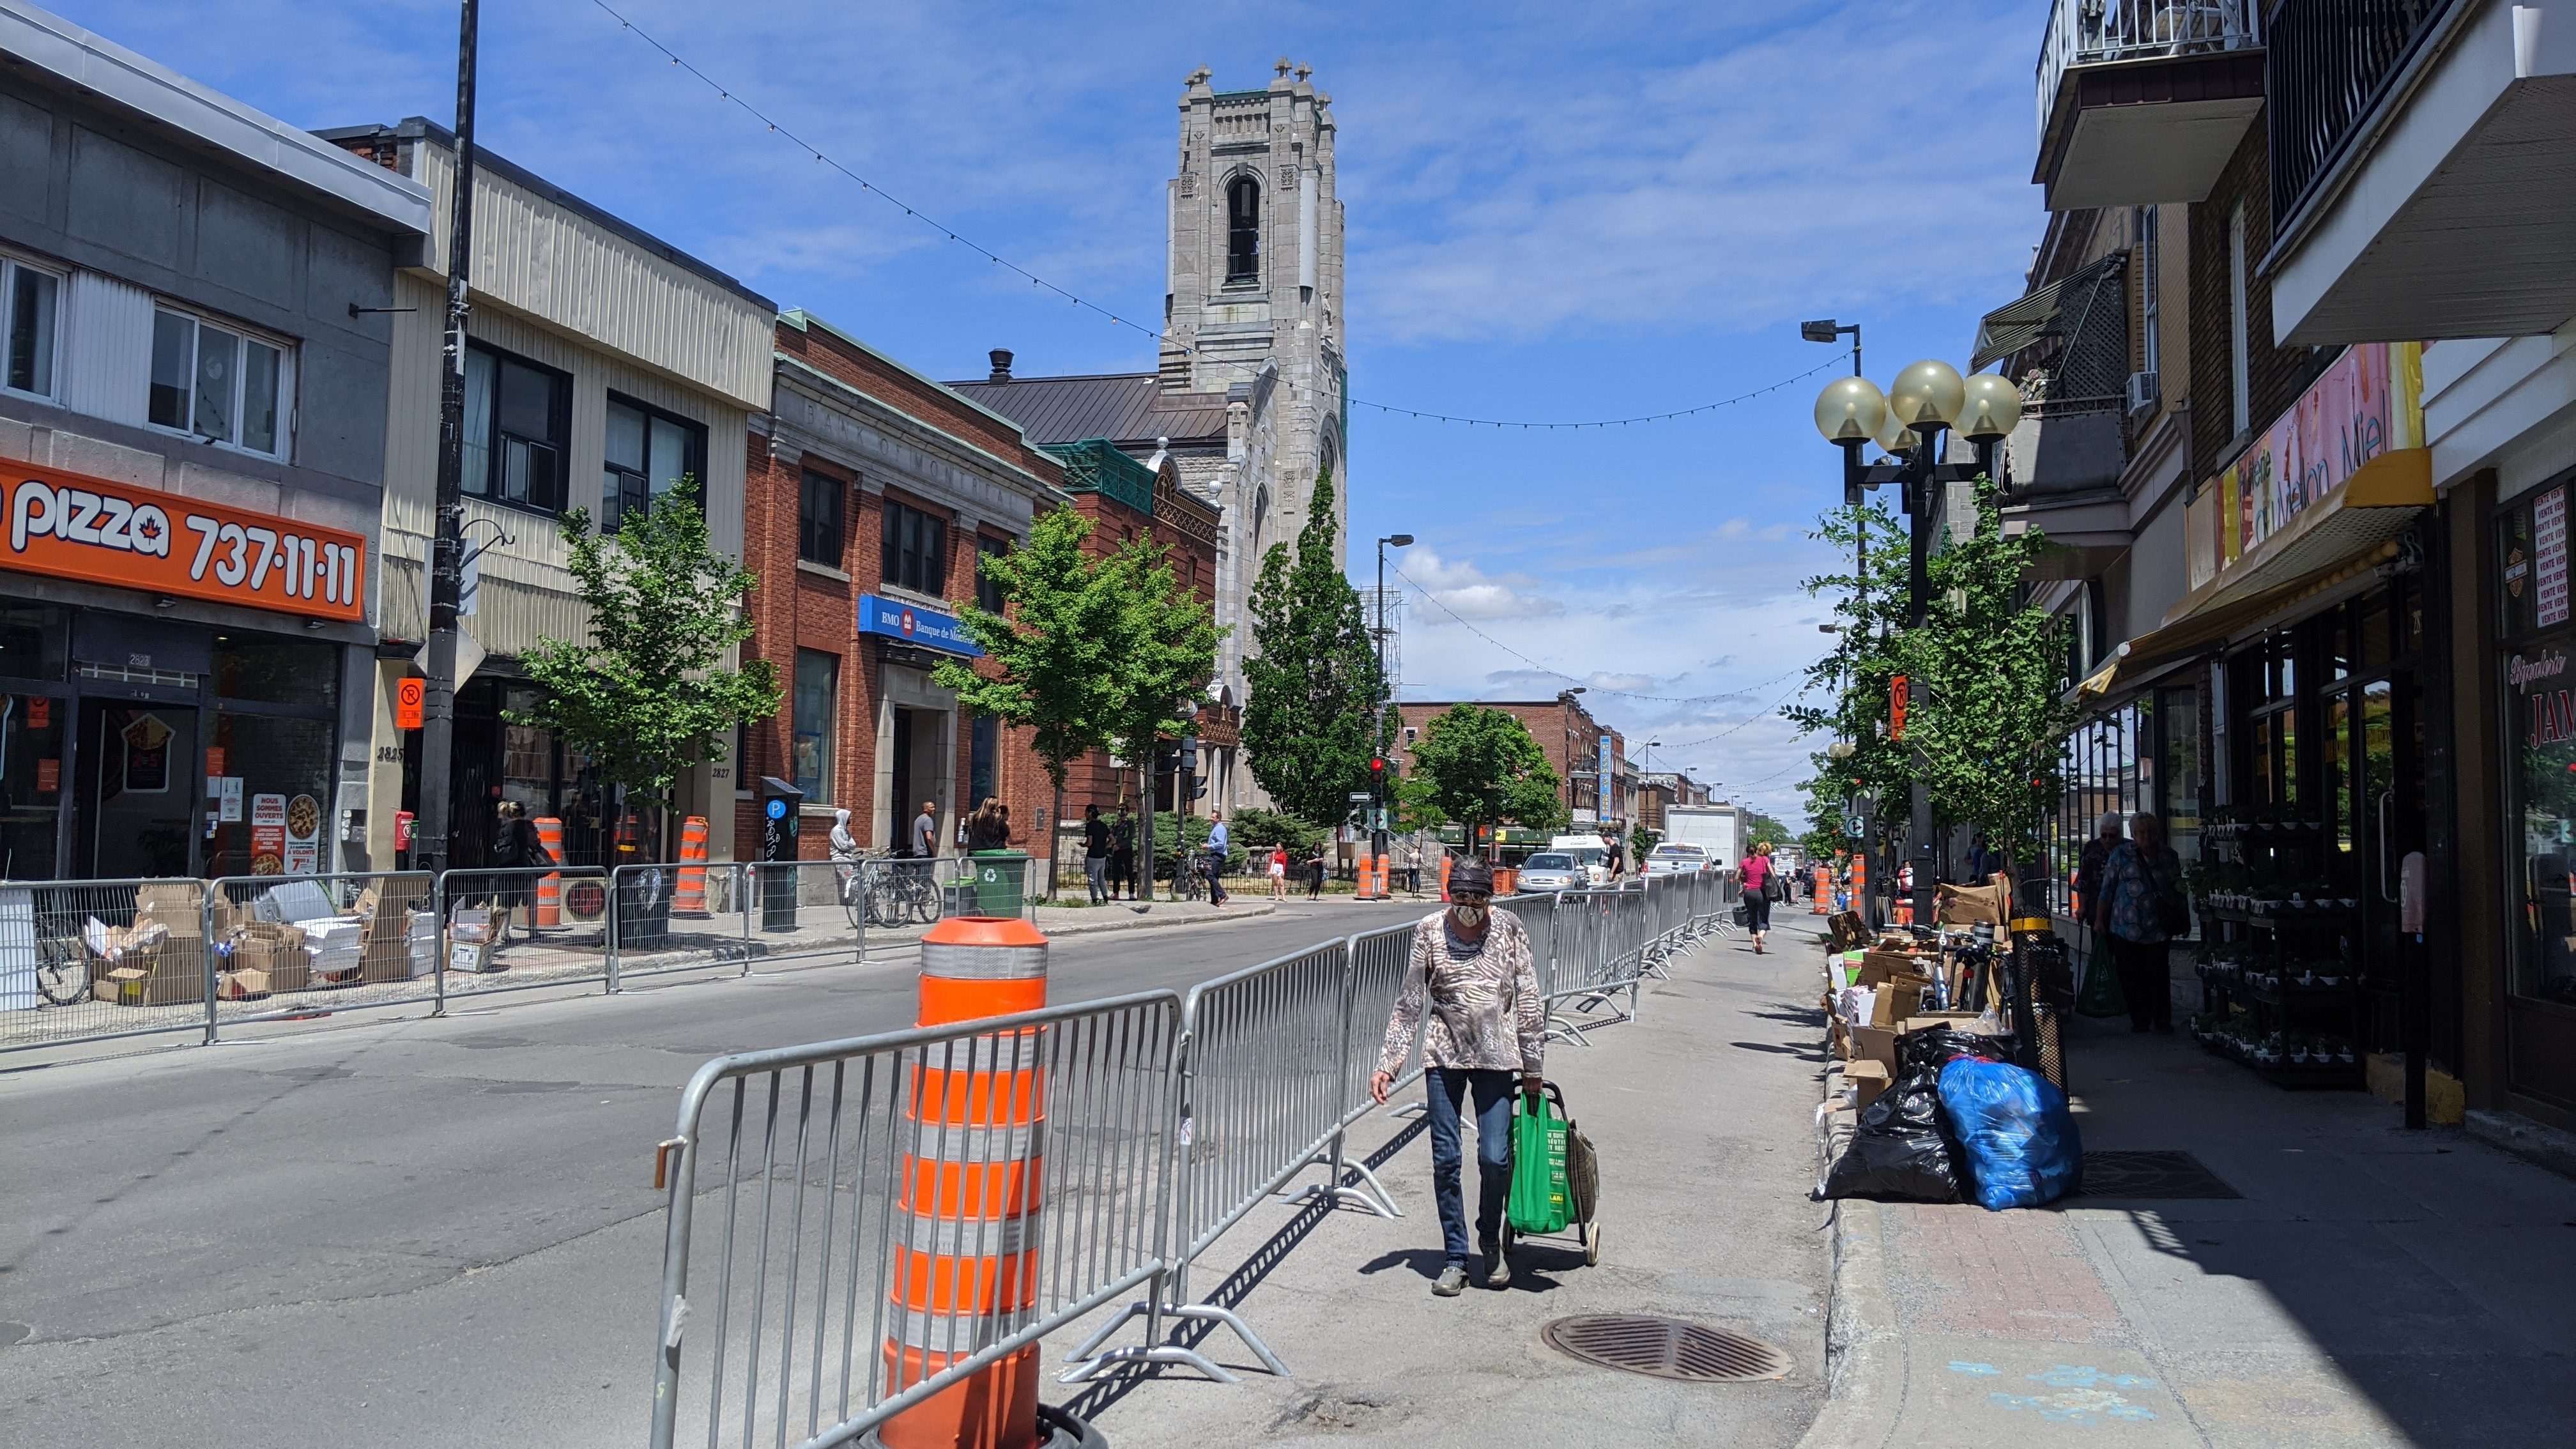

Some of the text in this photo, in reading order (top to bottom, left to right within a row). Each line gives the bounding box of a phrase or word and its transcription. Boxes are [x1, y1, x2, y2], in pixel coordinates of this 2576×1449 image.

[2342, 389, 2387, 478] Miel
[2535, 487, 2564, 507] VENTE VENT
[10, 480, 171, 558] pizza
[2538, 505, 2553, 519] VENTE
[2536, 514, 2566, 533] VENTE VENT
[2539, 532, 2554, 546] VENTE
[2536, 541, 2565, 560] VENTE VENT
[2540, 558, 2555, 572] VENTE
[2537, 569, 2566, 587] VENTE VENT
[2541, 587, 2556, 599] VENTE
[2538, 596, 2567, 613] VENTE VENT
[882, 612, 899, 626] BMO
[916, 620, 940, 638] Banque
[941, 627, 949, 638] de
[2542, 612, 2556, 624] VENTE
[130, 654, 150, 666] 2823
[2510, 649, 2566, 694] Bijouterie
[377, 746, 404, 762] 2825
[712, 768, 730, 778] 2827
